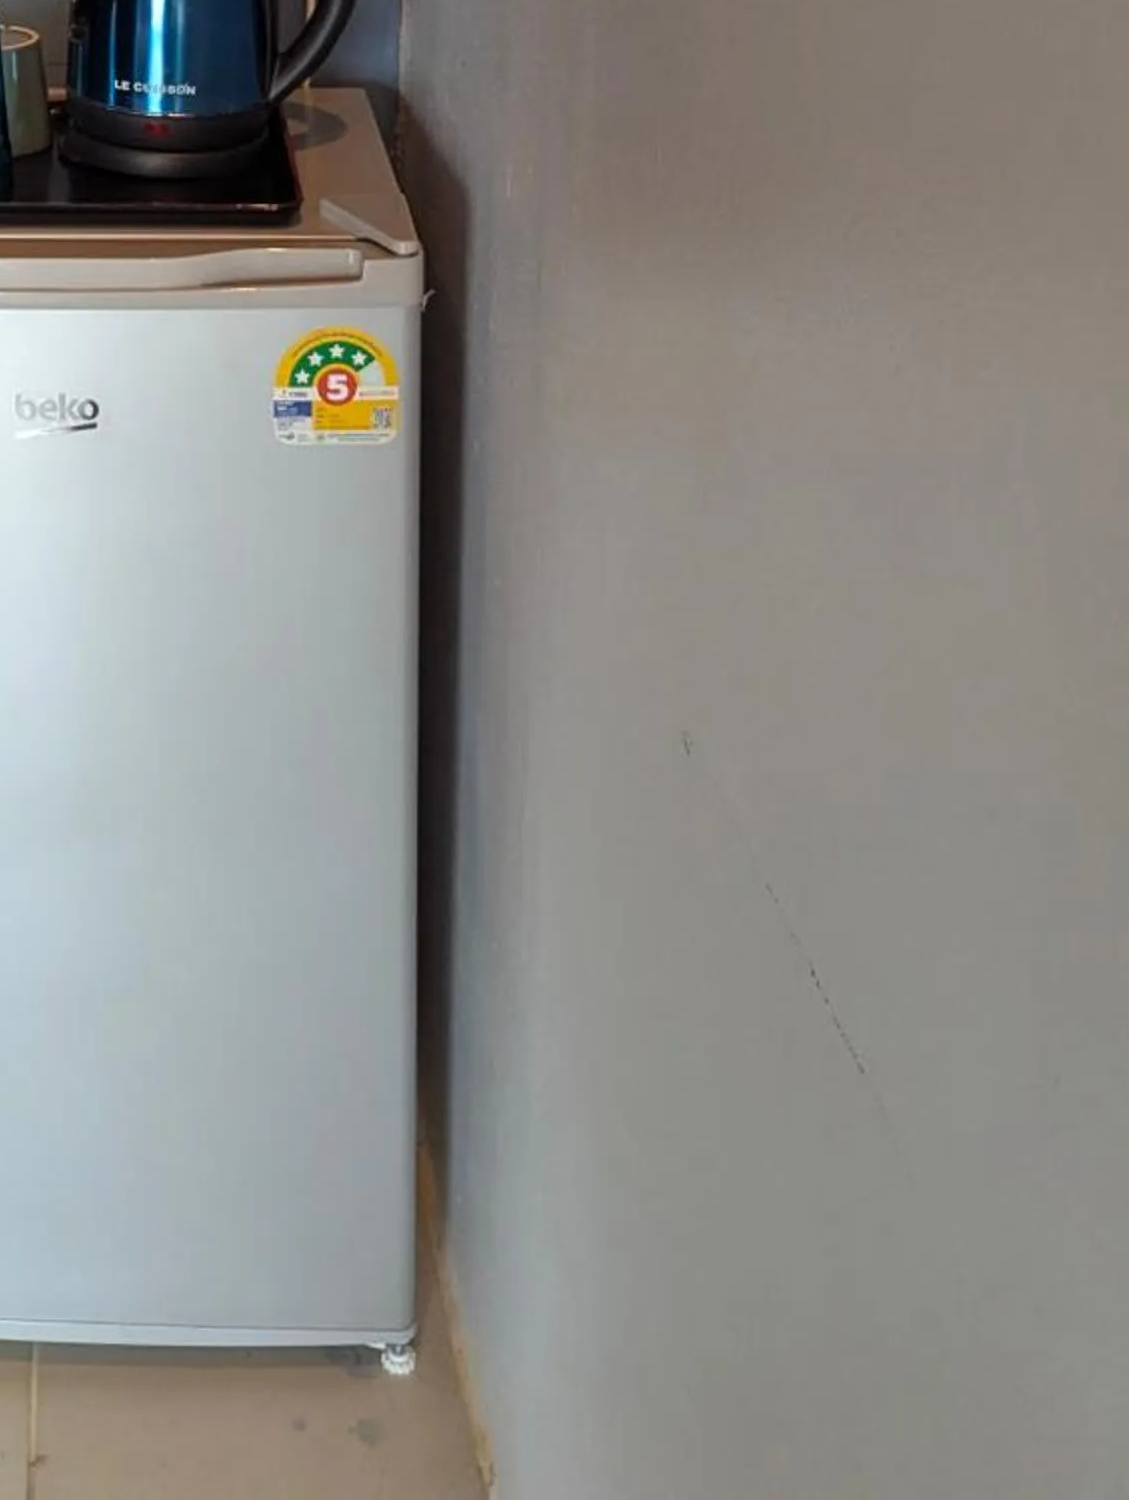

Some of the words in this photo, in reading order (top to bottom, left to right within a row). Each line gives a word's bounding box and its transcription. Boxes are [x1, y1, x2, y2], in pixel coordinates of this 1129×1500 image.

[114, 79, 130, 91] LE
[326, 373, 349, 401] 5
[15, 392, 100, 421] beko
